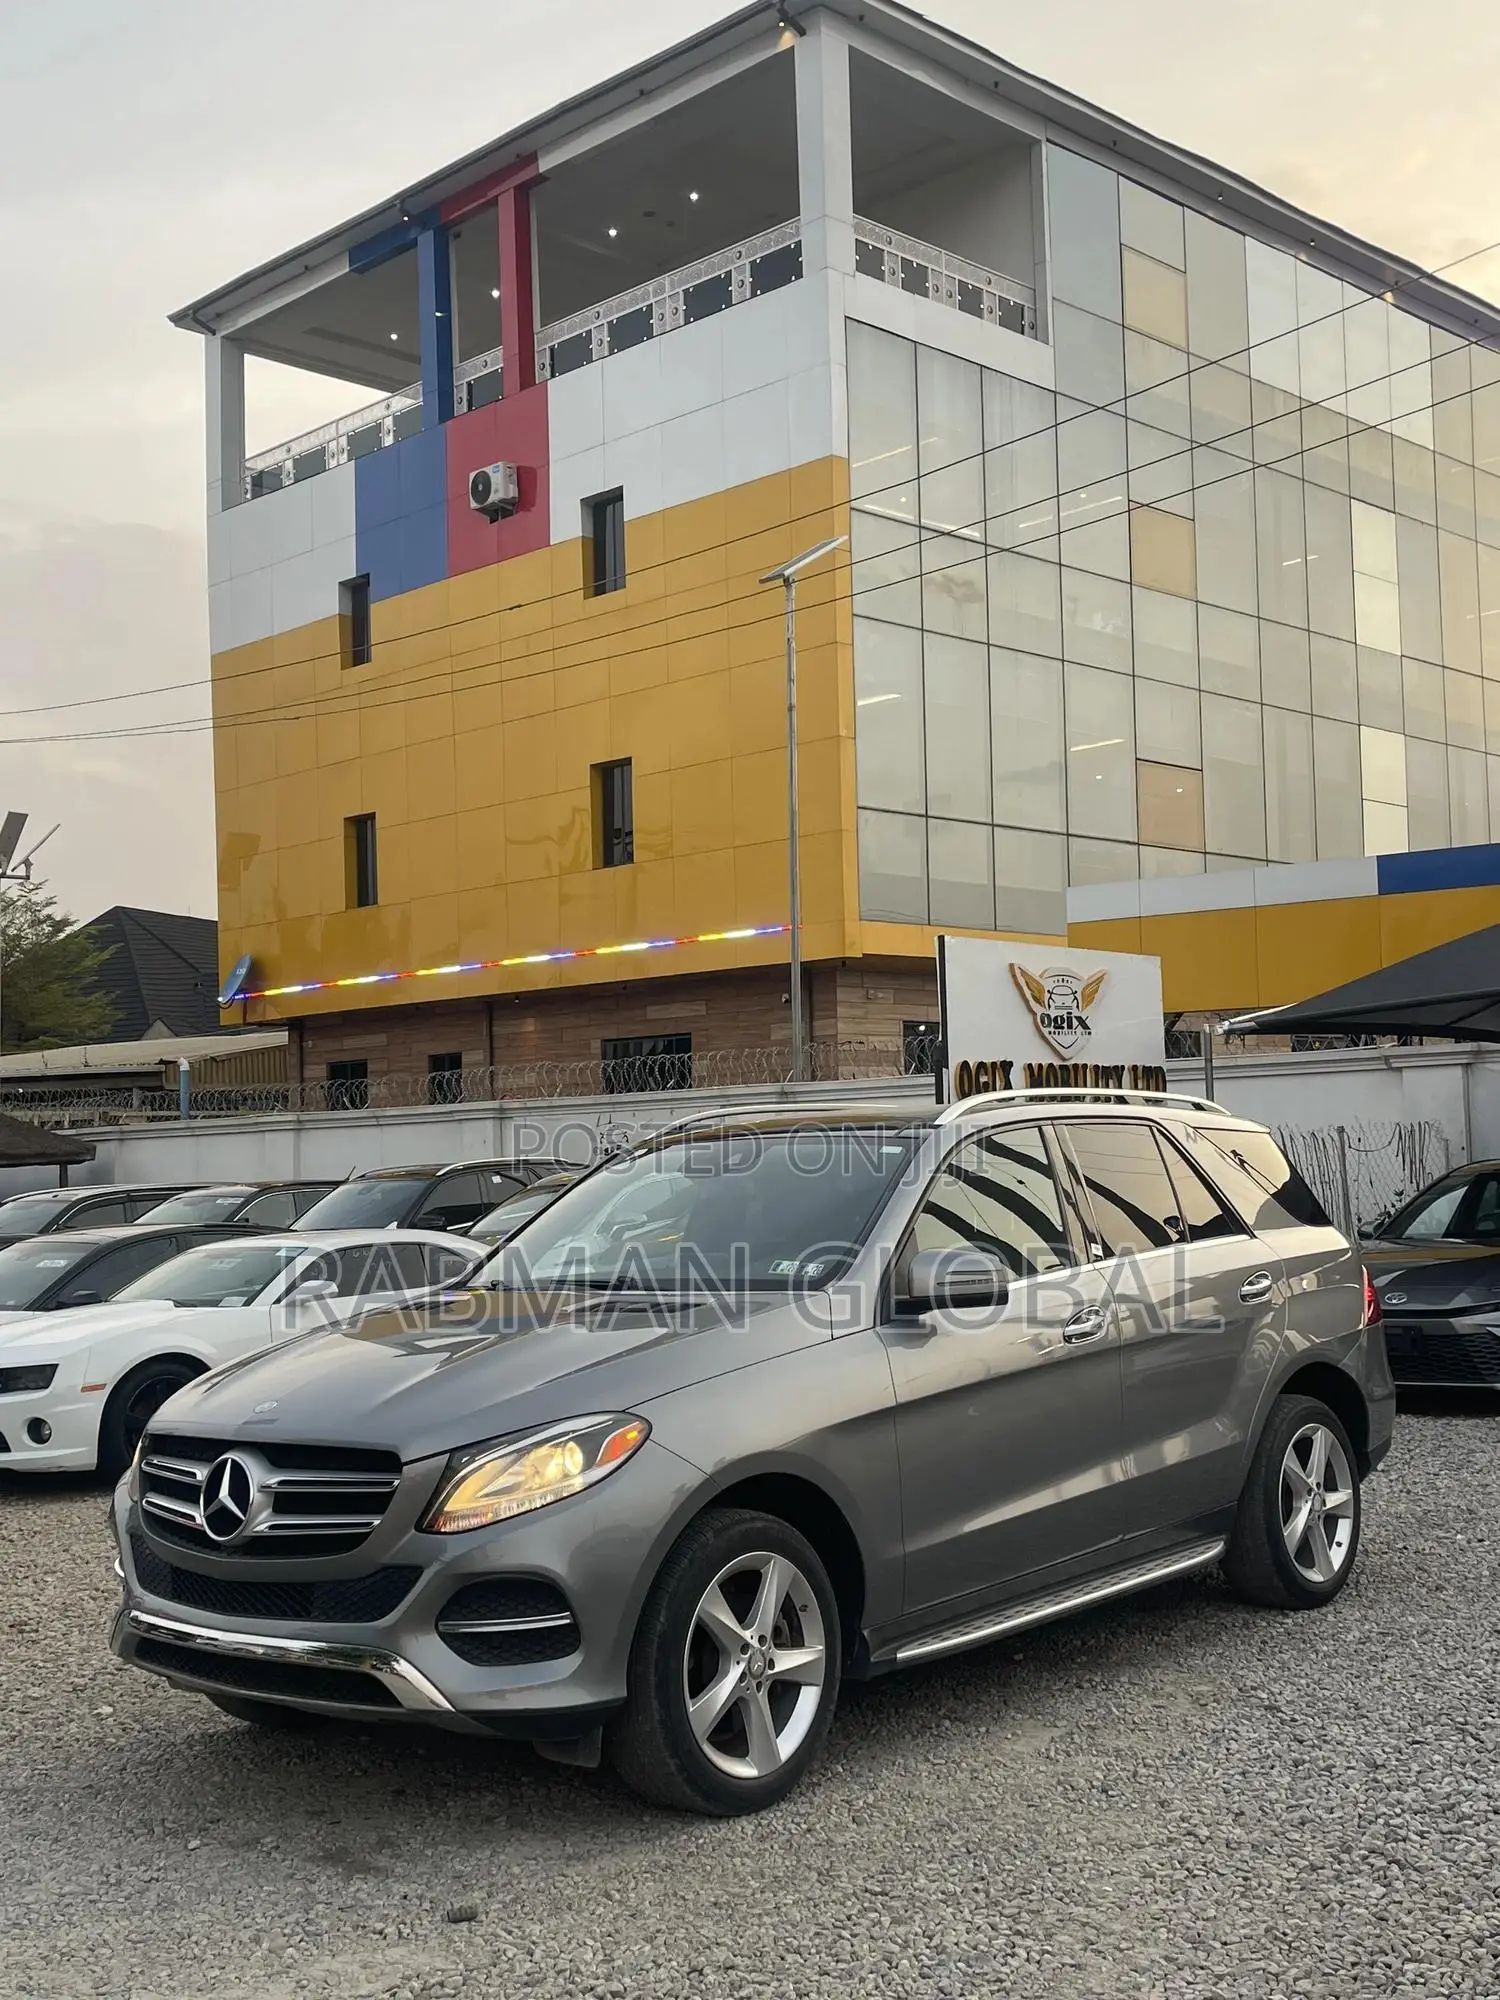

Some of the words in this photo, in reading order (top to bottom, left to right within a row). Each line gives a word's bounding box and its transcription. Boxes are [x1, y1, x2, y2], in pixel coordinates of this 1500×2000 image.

[954, 1060, 1015, 1102] OGIX
[1023, 1063, 1127, 1104] MOBILITY
[1128, 1065, 1167, 1103] LTD
